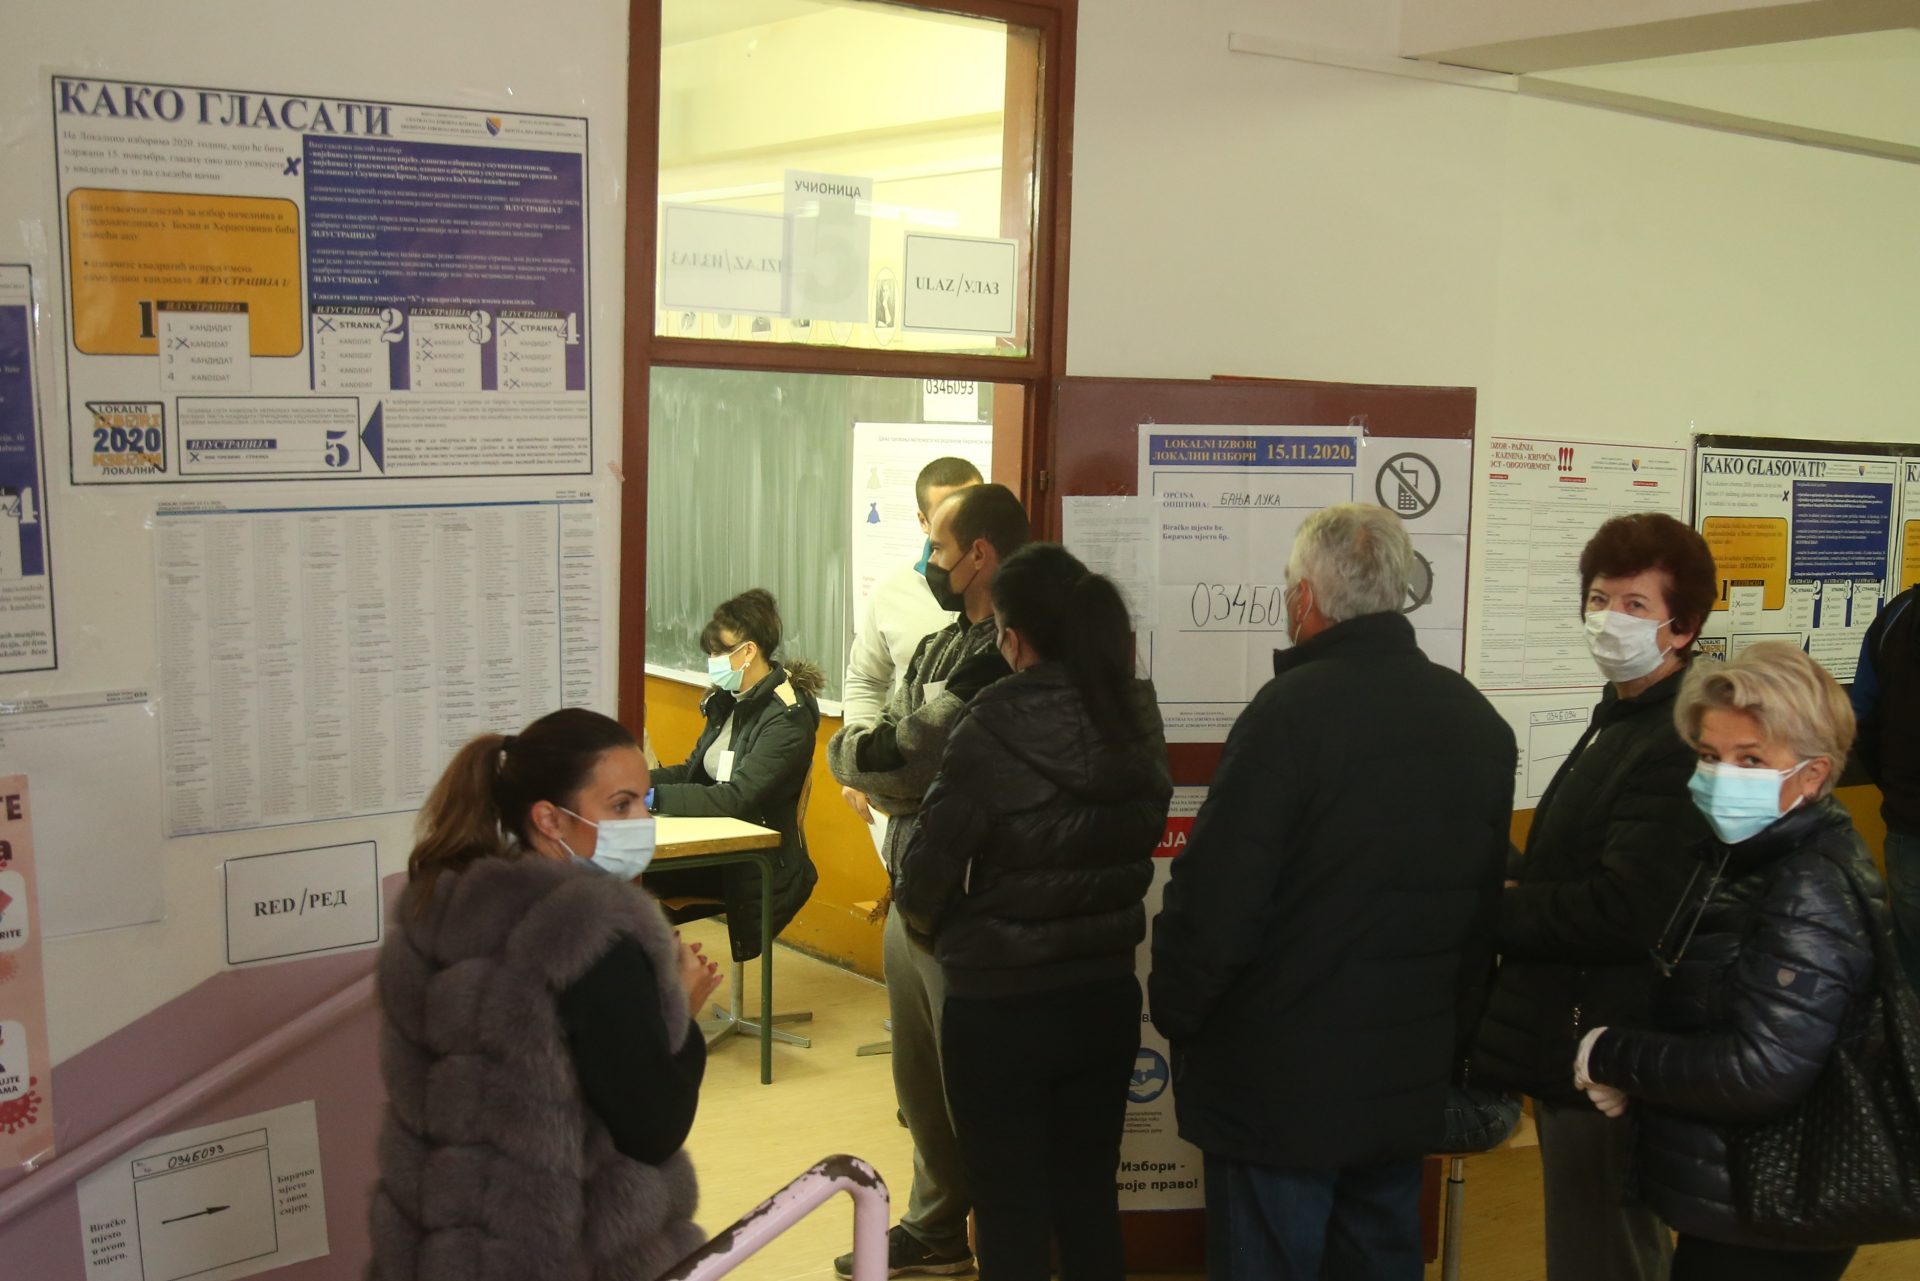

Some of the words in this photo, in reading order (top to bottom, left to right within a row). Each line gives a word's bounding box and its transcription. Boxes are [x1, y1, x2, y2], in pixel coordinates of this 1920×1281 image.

[59, 80, 185, 123] КАКО
[197, 91, 393, 137] ГЛАСАТИ
[794, 180, 861, 199] УЧИОНИЦА
[916, 274, 1000, 297] ULAZ/УЛАЗ
[138, 302, 156, 338] 1
[339, 321, 382, 330] STRANKA
[381, 308, 405, 344] 2
[434, 322, 473, 331] STRANKA
[468, 310, 492, 345] 3
[557, 312, 580, 345] 4
[99, 406, 148, 414] LOKALNI
[93, 427, 161, 453] 2020
[1165, 440, 1216, 449] LOKALNI
[1218, 440, 1257, 449] IZBORI
[325, 430, 350, 467] 5
[1152, 452, 1210, 461] ЛОКАЛНИ
[1213, 452, 1257, 461] ИЗБОРИ
[1267, 444, 1355, 461] 15.11.2020.
[102, 466, 155, 475] ЛОКАЛНИ
[1703, 456, 1744, 474] KAKO
[1747, 458, 1827, 478] GLASOVATI?
[1254, 494, 1281, 507] ЛУКА
[254, 888, 347, 917] RED/РЕД
[1121, 1161, 1177, 1174] Избори
[278, 1168, 315, 1184] Бирачко
[1151, 1178, 1199, 1192] право!
[90, 1217, 127, 1233] Biračko
[91, 1230, 122, 1245] mjesto
[100, 1242, 126, 1253] ovom
